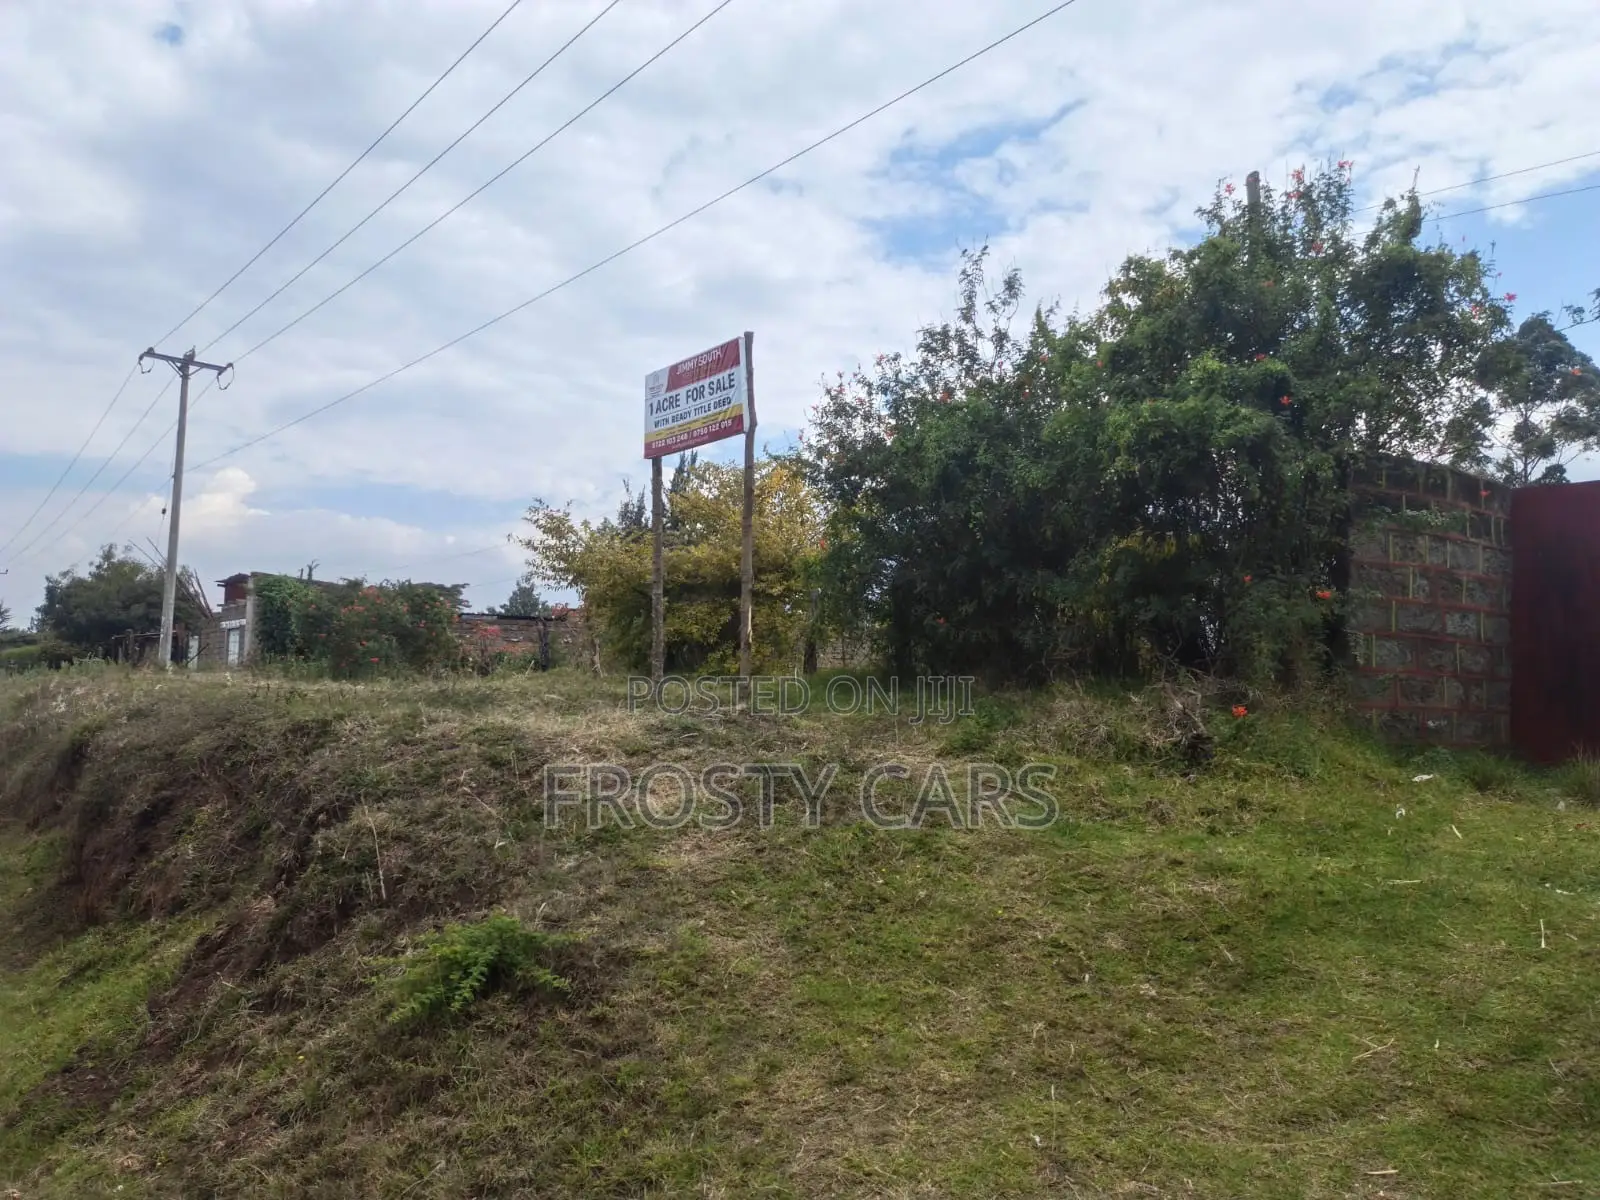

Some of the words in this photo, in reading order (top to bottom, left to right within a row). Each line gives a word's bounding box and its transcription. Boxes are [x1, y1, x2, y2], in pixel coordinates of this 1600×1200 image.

[676, 360, 699, 374] JIMMY
[649, 402, 654, 416] 1
[655, 393, 681, 414] ACRE
[686, 385, 705, 404] FOR
[708, 373, 735, 396] SALE
[654, 417, 670, 429] WITH
[671, 410, 692, 424] READY
[694, 403, 711, 416] TITLE
[713, 396, 732, 409] DEED
